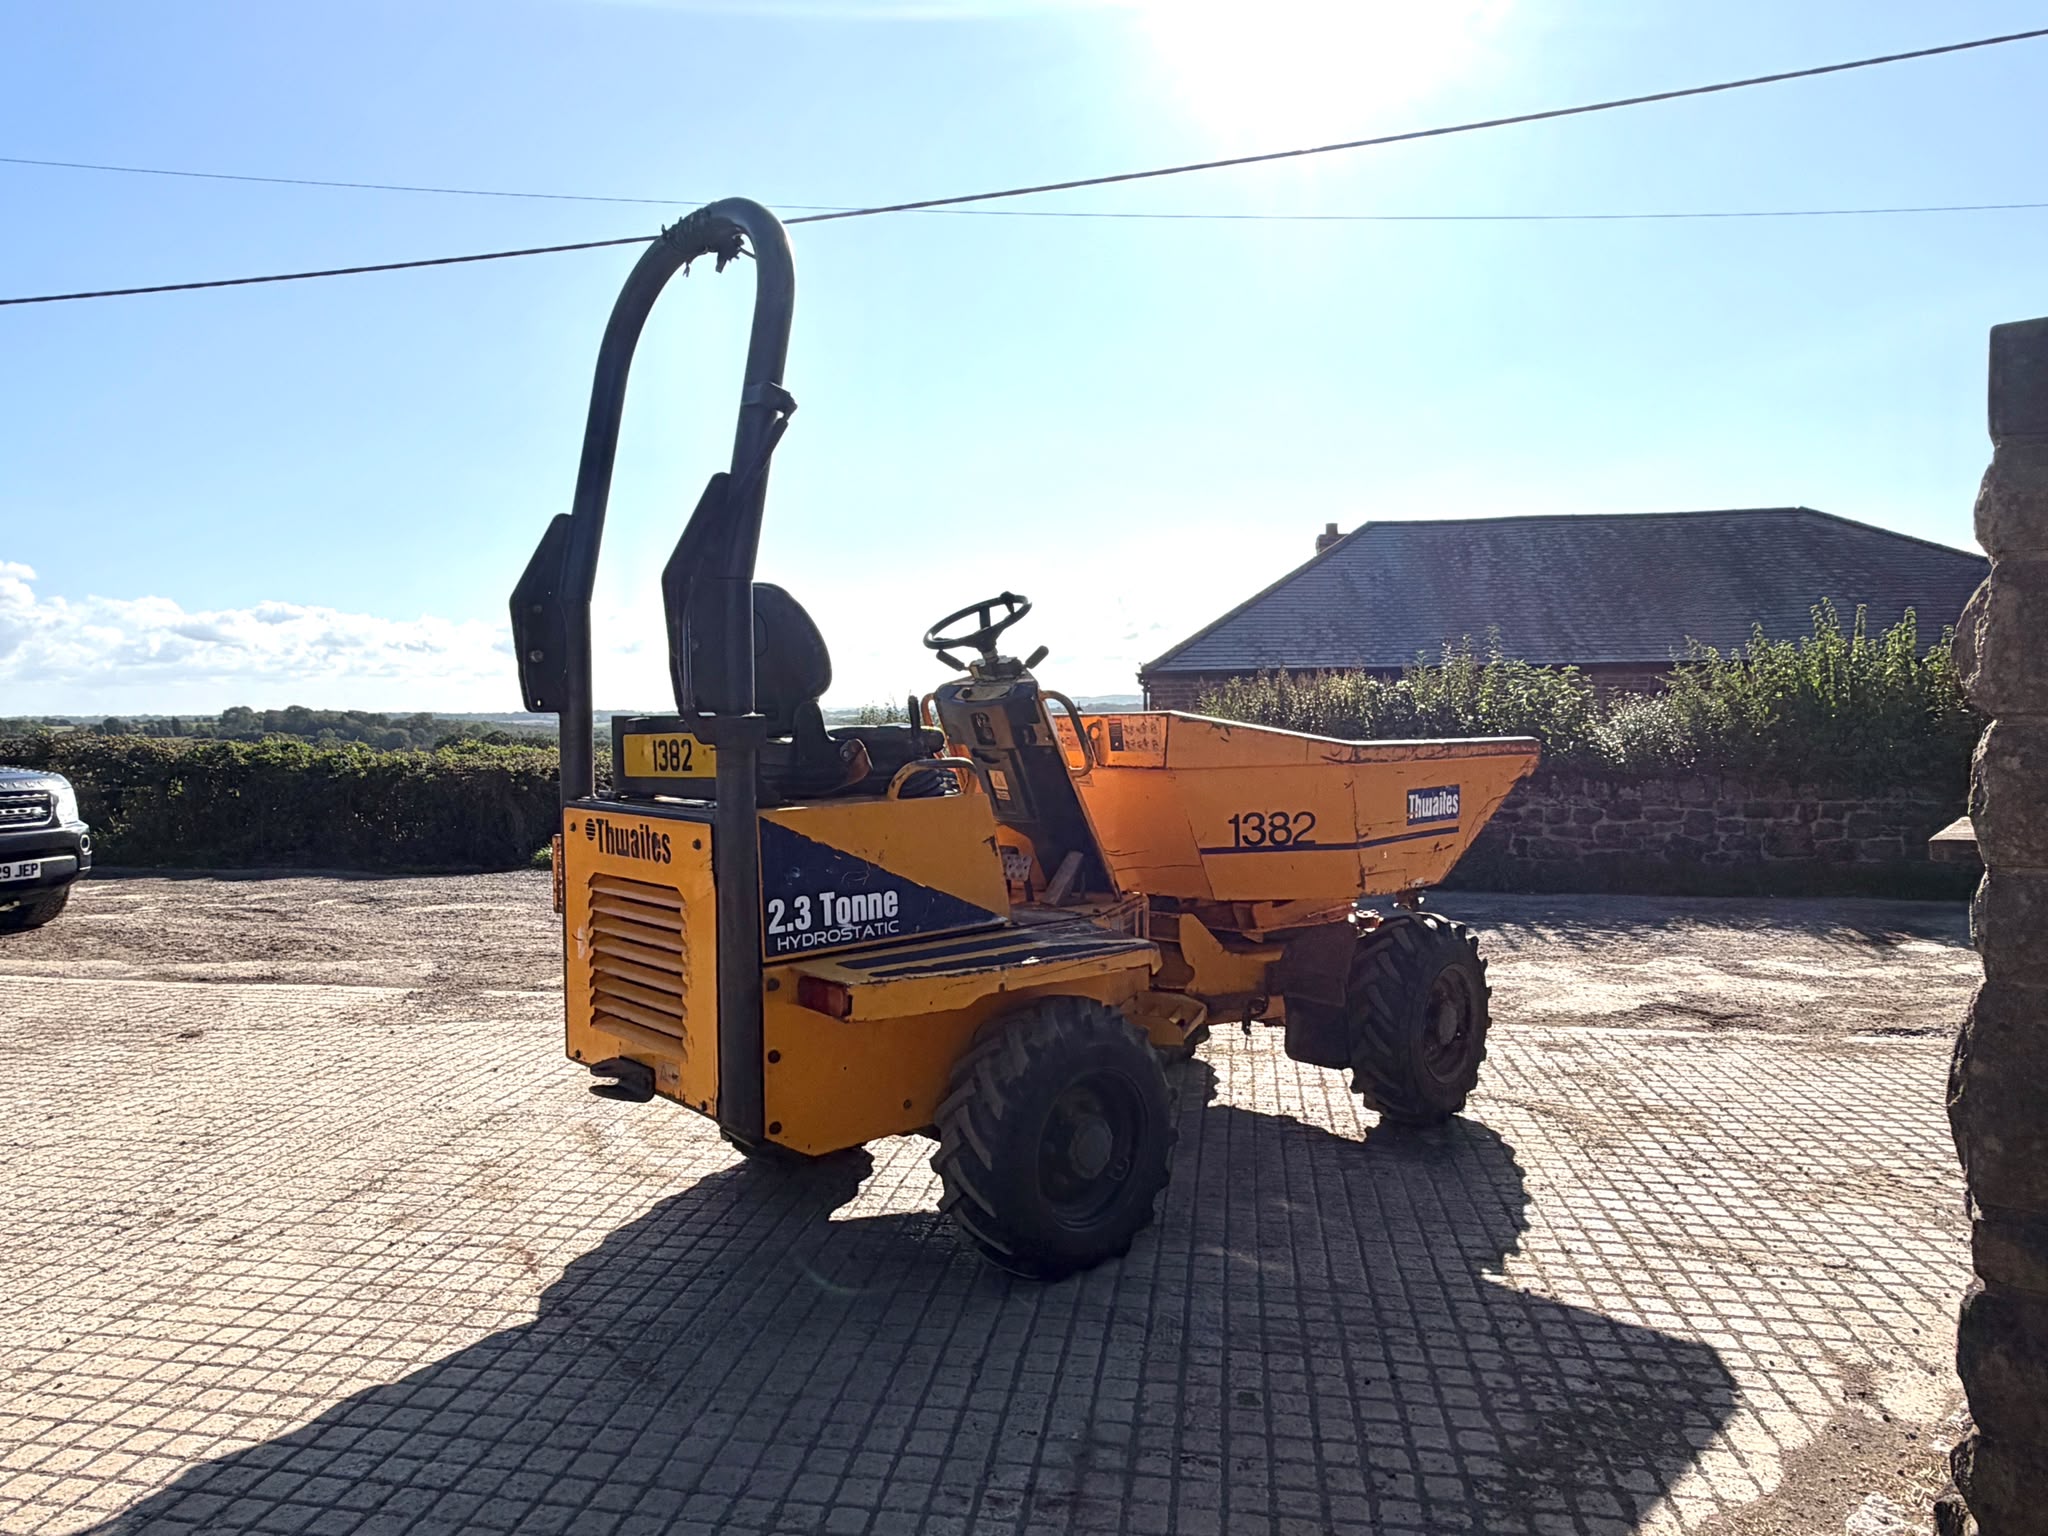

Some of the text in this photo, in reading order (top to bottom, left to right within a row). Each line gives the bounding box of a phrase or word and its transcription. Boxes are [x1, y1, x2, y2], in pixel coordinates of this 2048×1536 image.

[653, 739, 693, 772] 1382
[1408, 791, 1459, 819] Thwaites
[596, 818, 672, 865] Thwaites
[1228, 811, 1316, 847] 1382
[14, 863, 39, 878] JEP
[768, 890, 899, 935] 2.3 Tonne
[777, 920, 900, 951] HYDROSTATIC
